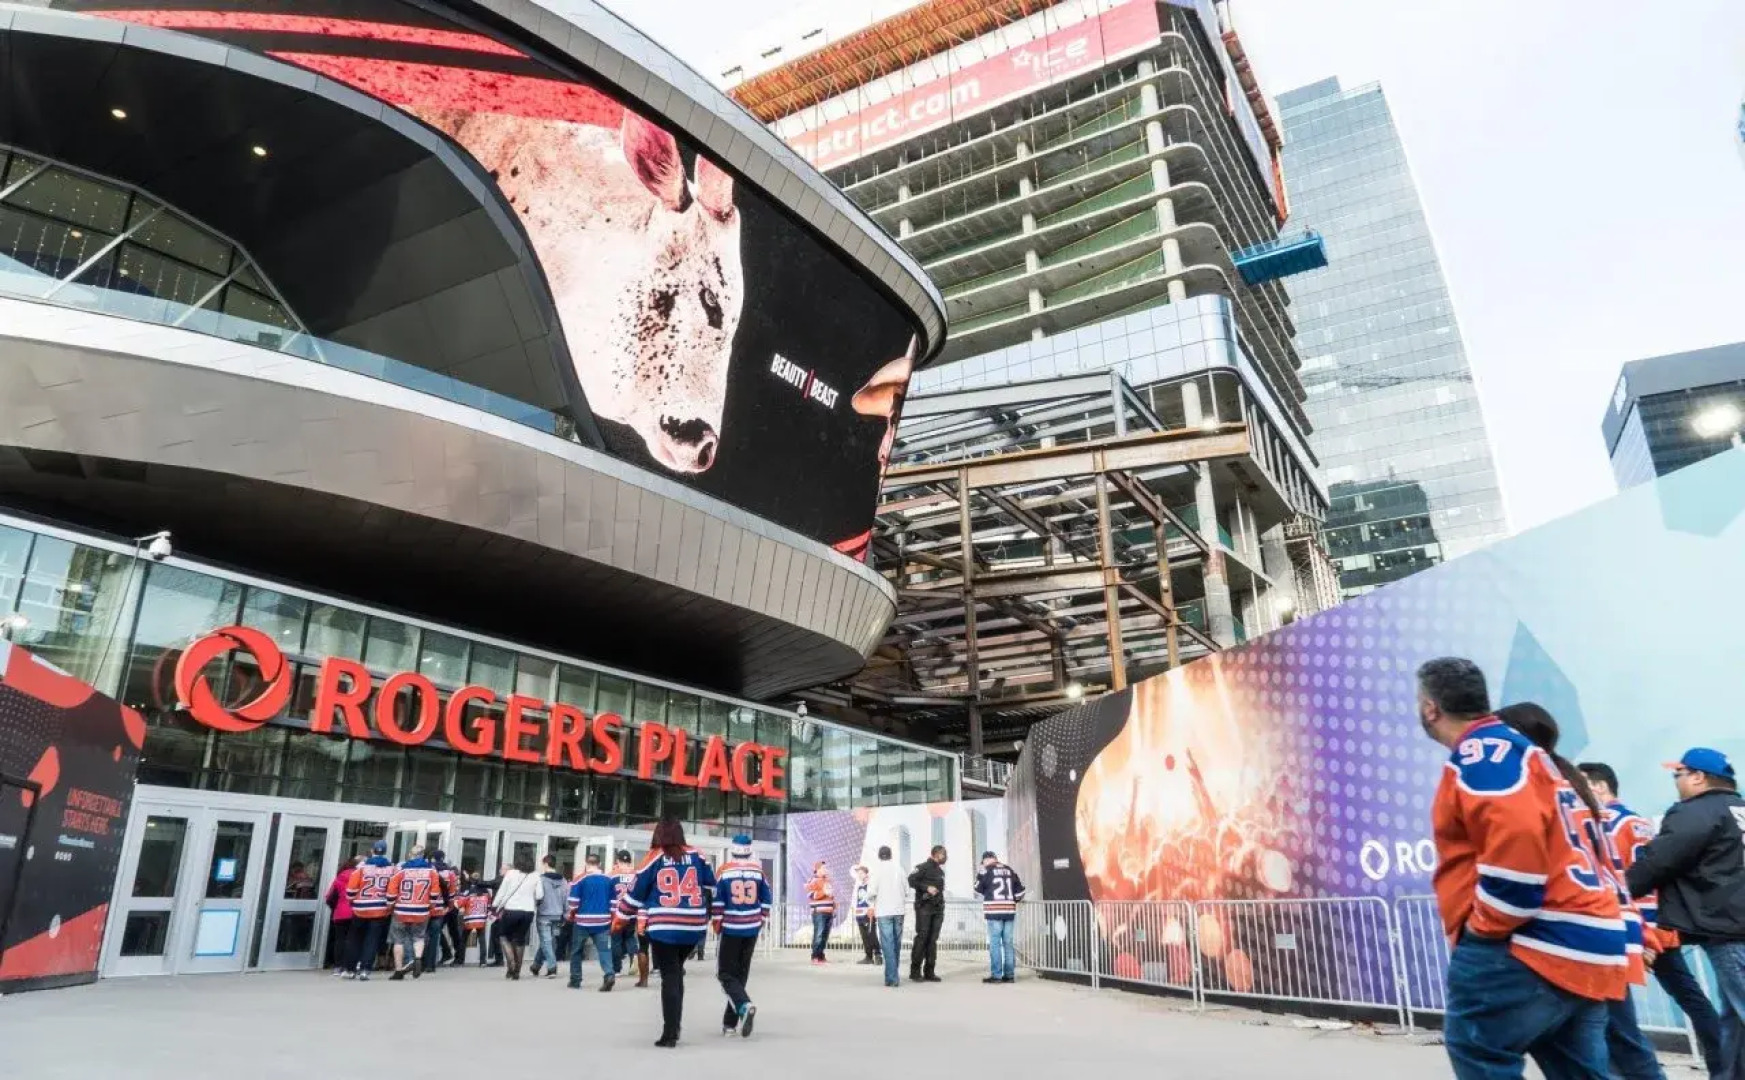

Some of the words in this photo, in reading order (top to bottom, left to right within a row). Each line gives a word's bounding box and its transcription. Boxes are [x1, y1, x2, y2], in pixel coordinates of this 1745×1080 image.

[770, 353, 808, 390] BEAUTY
[810, 378, 839, 409] BEAST
[310, 656, 623, 775] ROGERS
[638, 722, 790, 800] PLACE
[1459, 737, 1512, 765] 97
[360, 876, 389, 899] 29
[400, 878, 431, 901] 97
[657, 866, 703, 907] 94
[731, 880, 757, 904] 93
[993, 877, 1014, 900] 21
